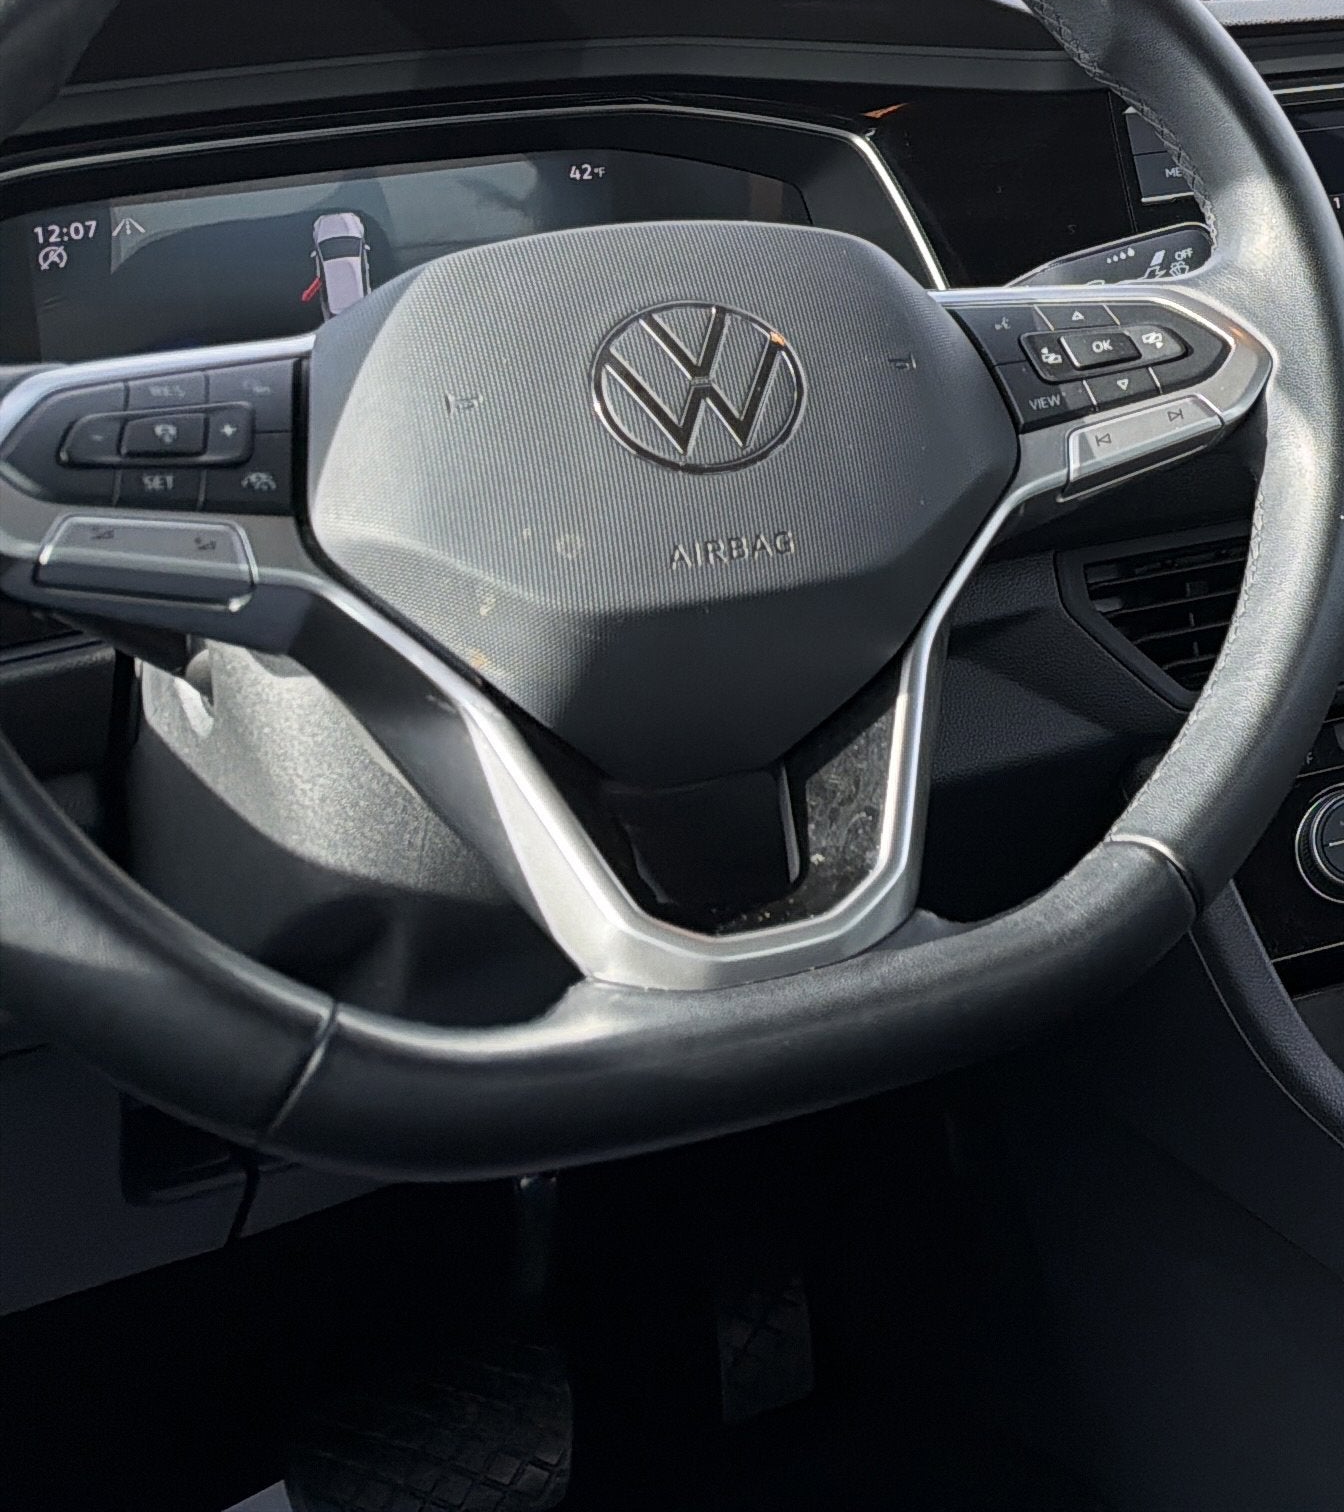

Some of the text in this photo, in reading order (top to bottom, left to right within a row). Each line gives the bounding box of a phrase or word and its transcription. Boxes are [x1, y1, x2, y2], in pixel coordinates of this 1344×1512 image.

[1333, 197, 1341, 209] 1
[33, 220, 97, 244] 12:07
[1175, 248, 1193, 261] OFF
[1092, 339, 1113, 354] OK
[1028, 395, 1061, 411] VIEW
[142, 474, 174, 492] SET
[671, 530, 795, 571] AIRBAG
